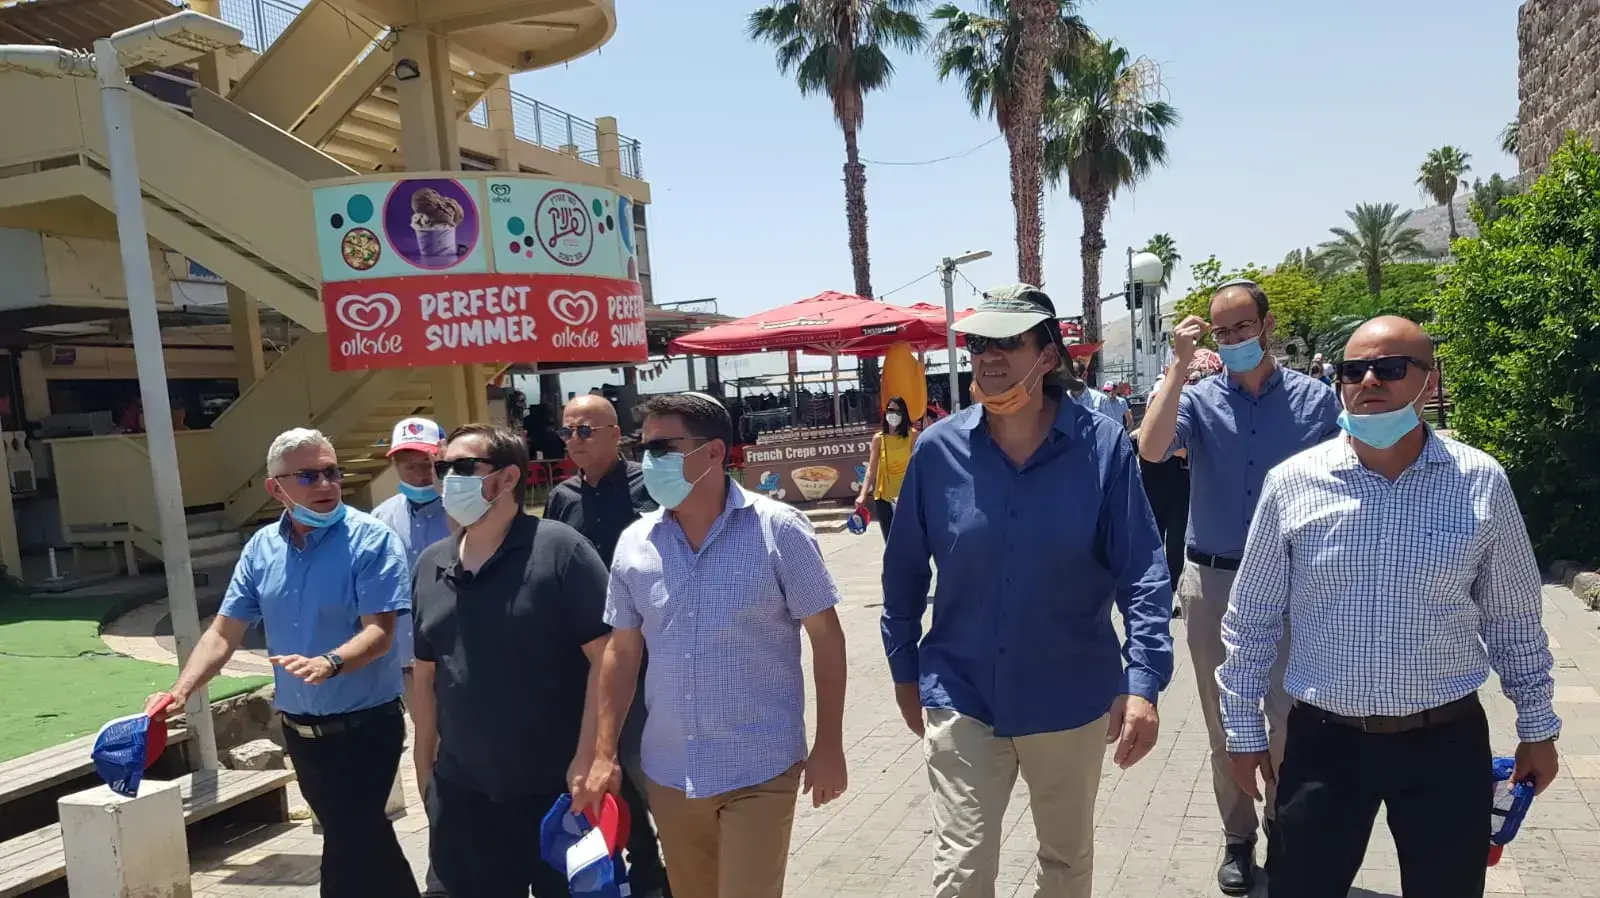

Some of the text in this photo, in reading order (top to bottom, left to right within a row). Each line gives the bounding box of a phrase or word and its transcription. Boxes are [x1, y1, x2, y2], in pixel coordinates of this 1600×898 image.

[418, 286, 531, 321] PERFECT
[340, 331, 403, 357] שטראוס
[425, 315, 538, 351] SUMMER
[552, 326, 600, 348] שטראוס
[746, 446, 816, 463] French Crepe
[818, 441, 873, 456] רפ צרפתי
